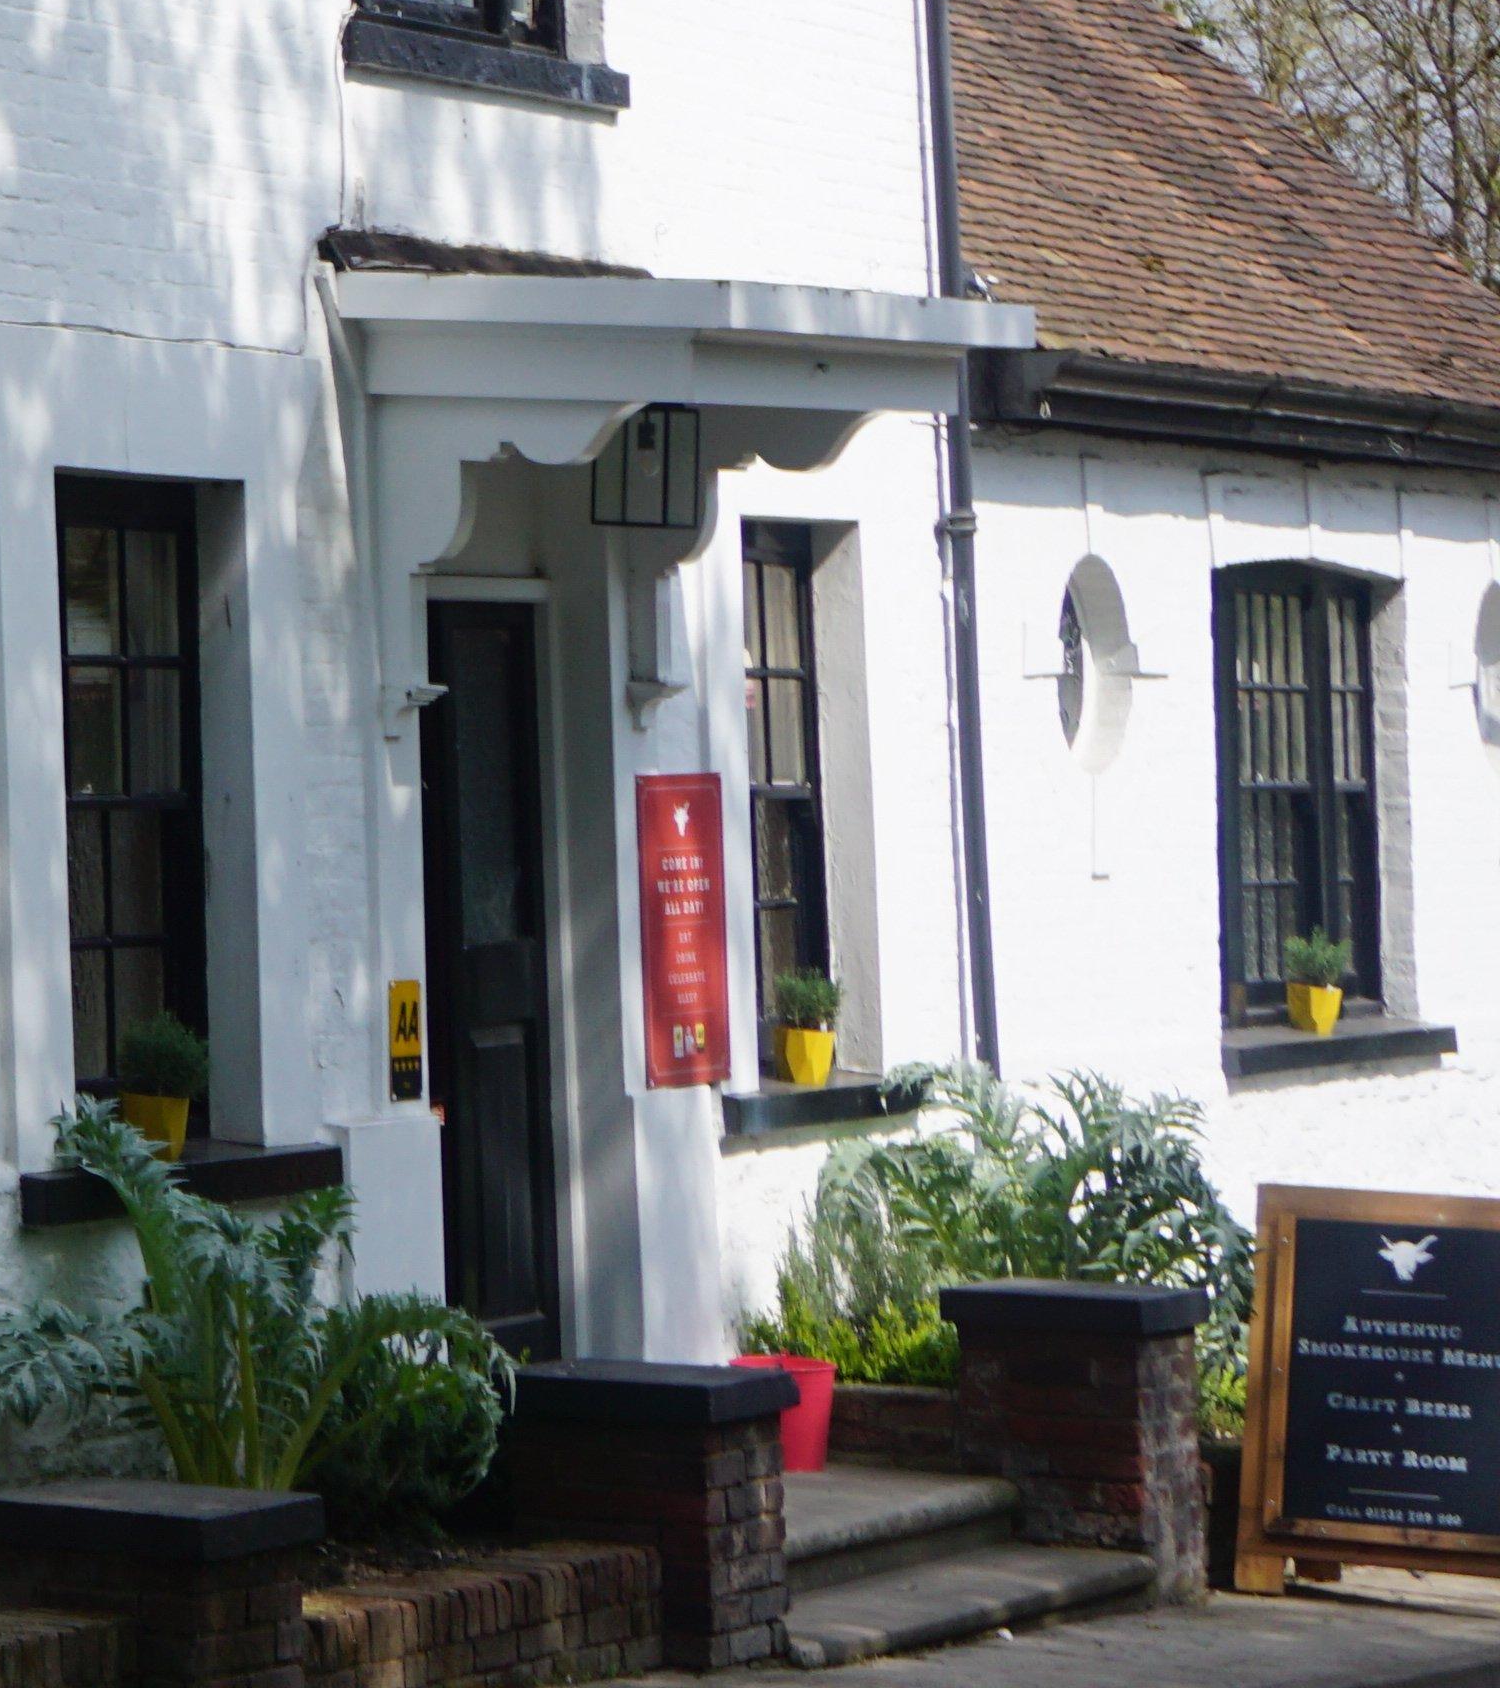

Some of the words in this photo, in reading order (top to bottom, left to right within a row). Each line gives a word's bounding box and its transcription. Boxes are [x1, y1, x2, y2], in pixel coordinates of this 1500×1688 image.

[687, 877, 710, 892] OPEN
[664, 900, 681, 915] ALL
[396, 1001, 419, 1043] AA
[1342, 1315, 1462, 1340] AUTHENTIC
[1298, 1338, 1433, 1364] SMOKEHOUSE
[1326, 1392, 1397, 1413] CRAFT
[1406, 1398, 1471, 1419] BEERS
[1326, 1444, 1393, 1466] PARTY
[1403, 1450, 1468, 1473] ROOM
